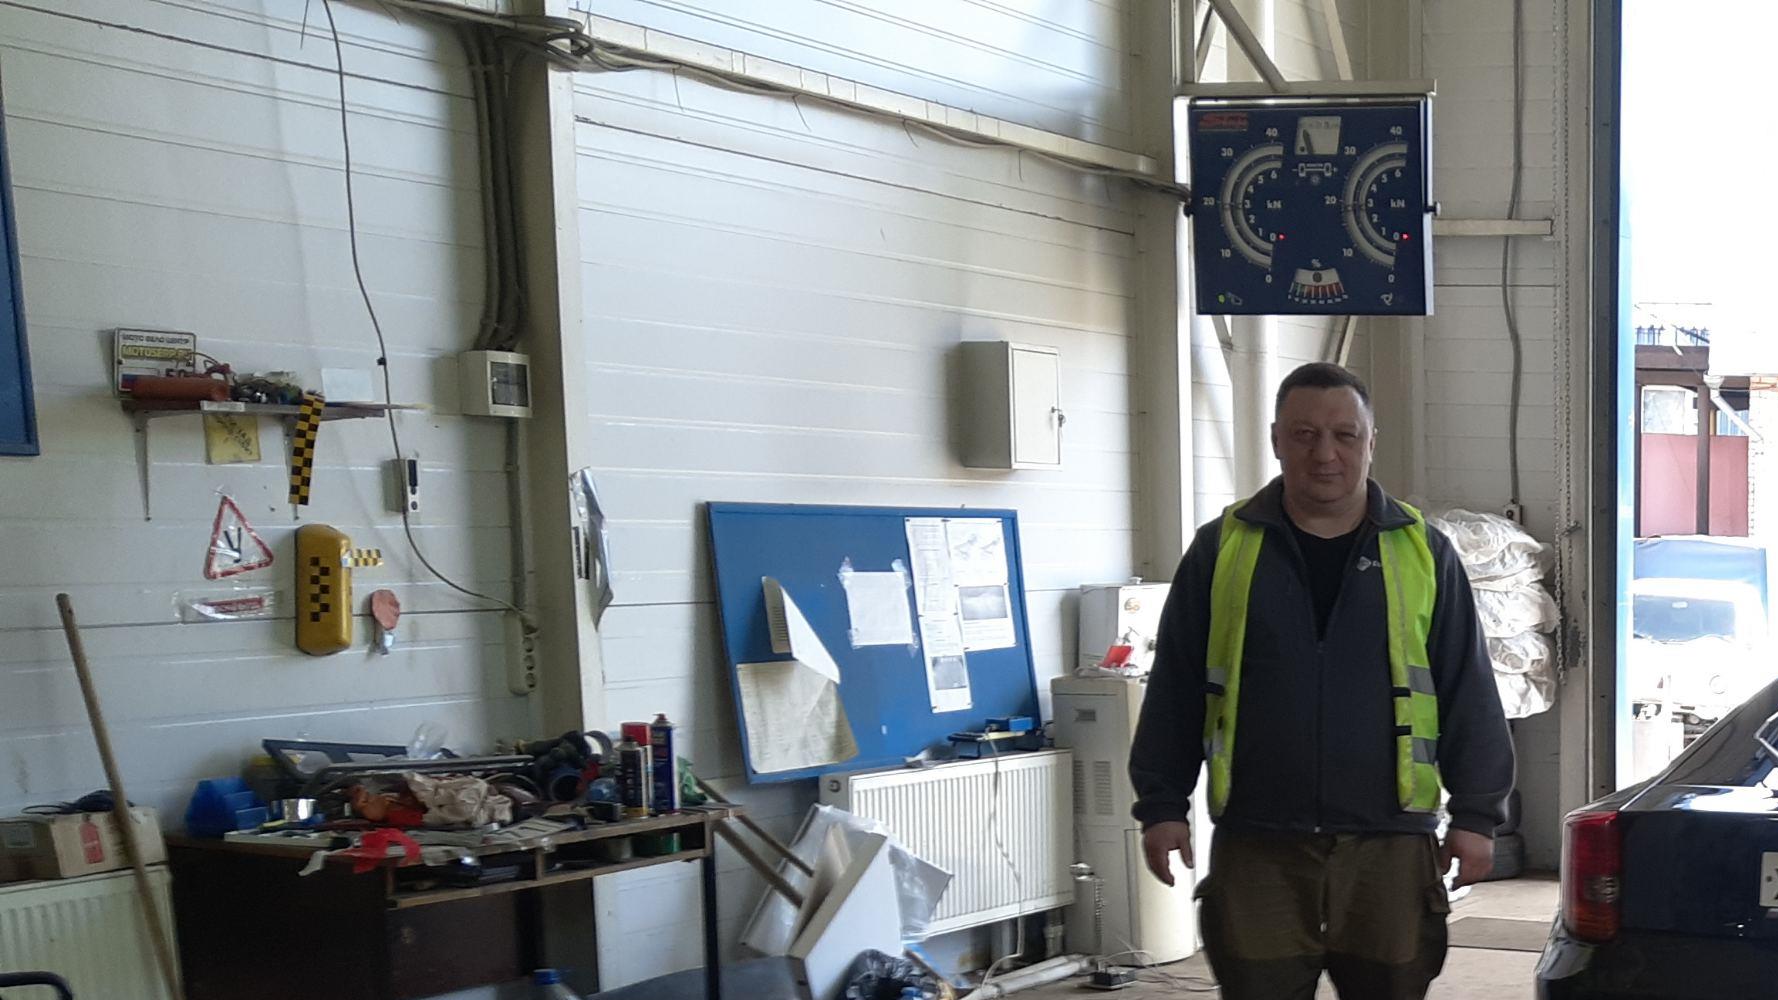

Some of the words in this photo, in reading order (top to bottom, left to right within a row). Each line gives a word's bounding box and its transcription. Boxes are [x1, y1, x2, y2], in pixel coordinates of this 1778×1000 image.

[1265, 127, 1278, 137] 40
[1390, 125, 1402, 135] 40
[1221, 147, 1233, 157] 30
[1344, 146, 1356, 155] 30
[1203, 196, 1215, 206] 20
[1266, 200, 1281, 210] kN
[1325, 195, 1337, 205] 20
[1390, 199, 1405, 209] kN
